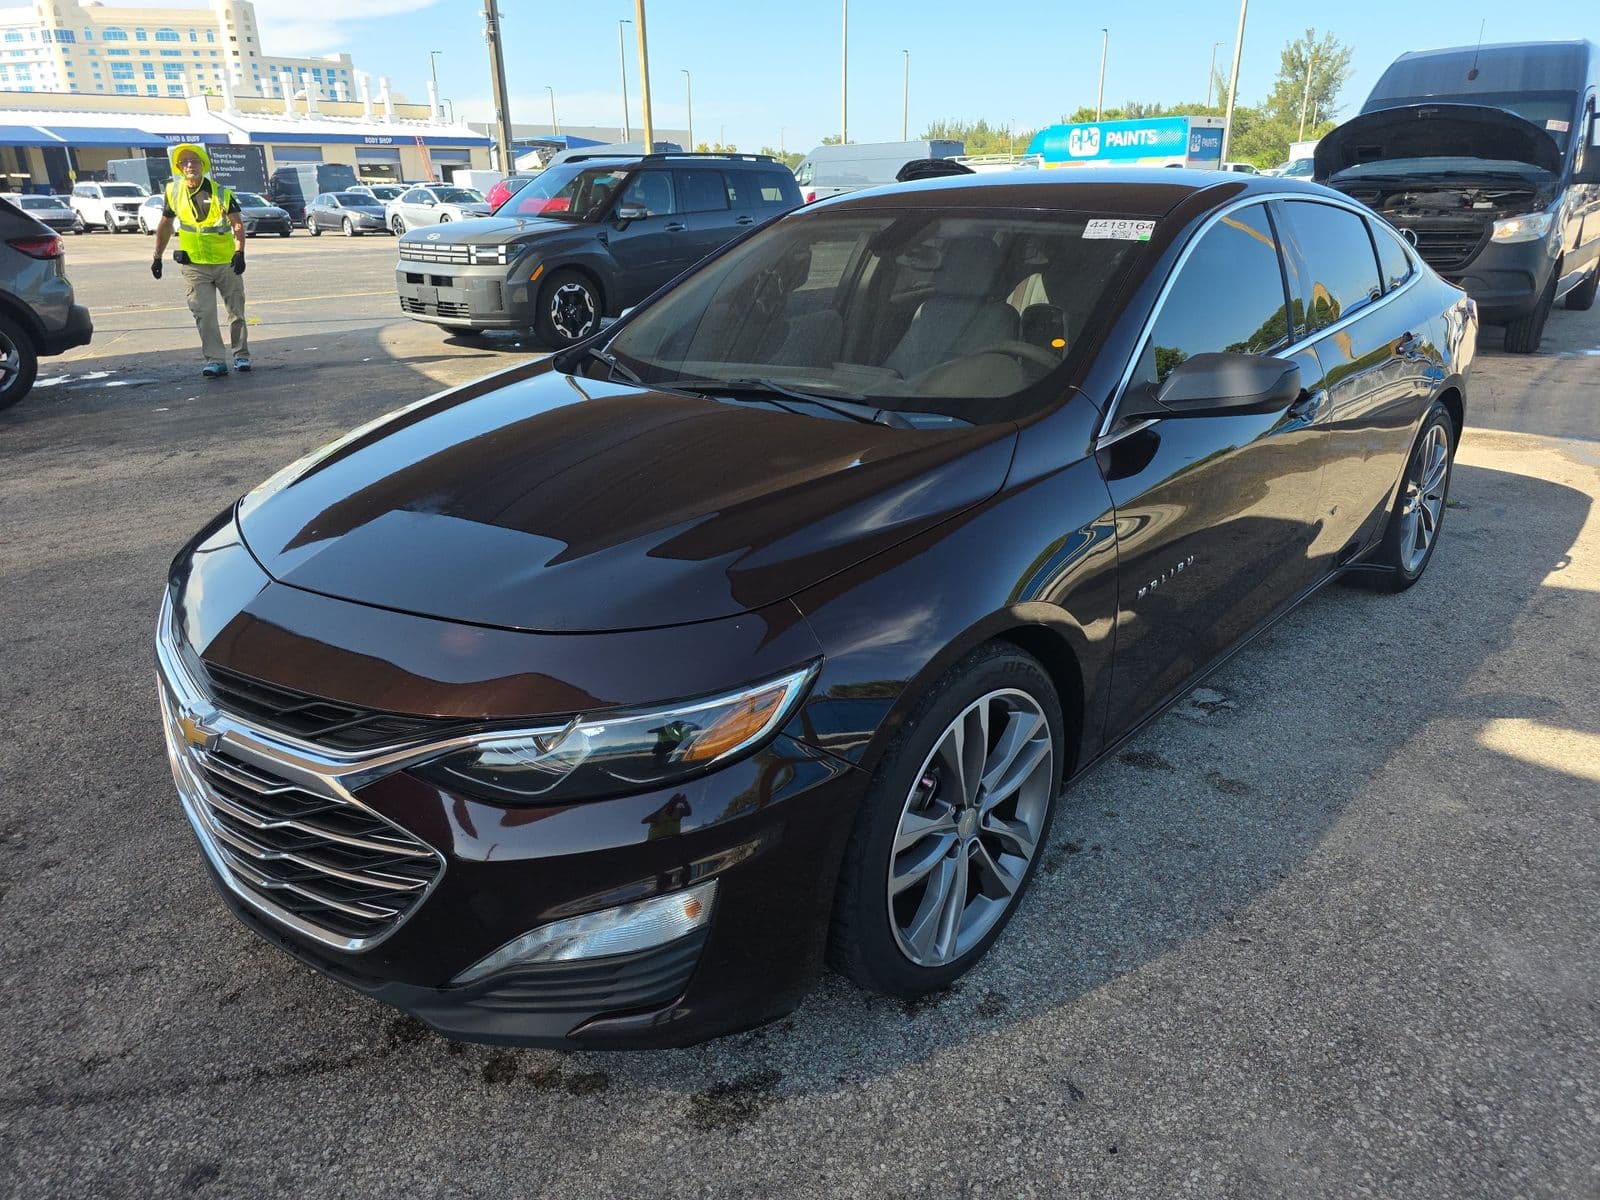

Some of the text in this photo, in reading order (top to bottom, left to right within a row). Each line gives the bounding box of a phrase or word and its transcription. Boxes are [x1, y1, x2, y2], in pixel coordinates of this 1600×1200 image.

[1105, 129, 1157, 147] PAINTS
[1202, 137, 1217, 147] PAINTS
[1089, 221, 1154, 231] 4418164
[1138, 555, 1194, 600] MALIBU
